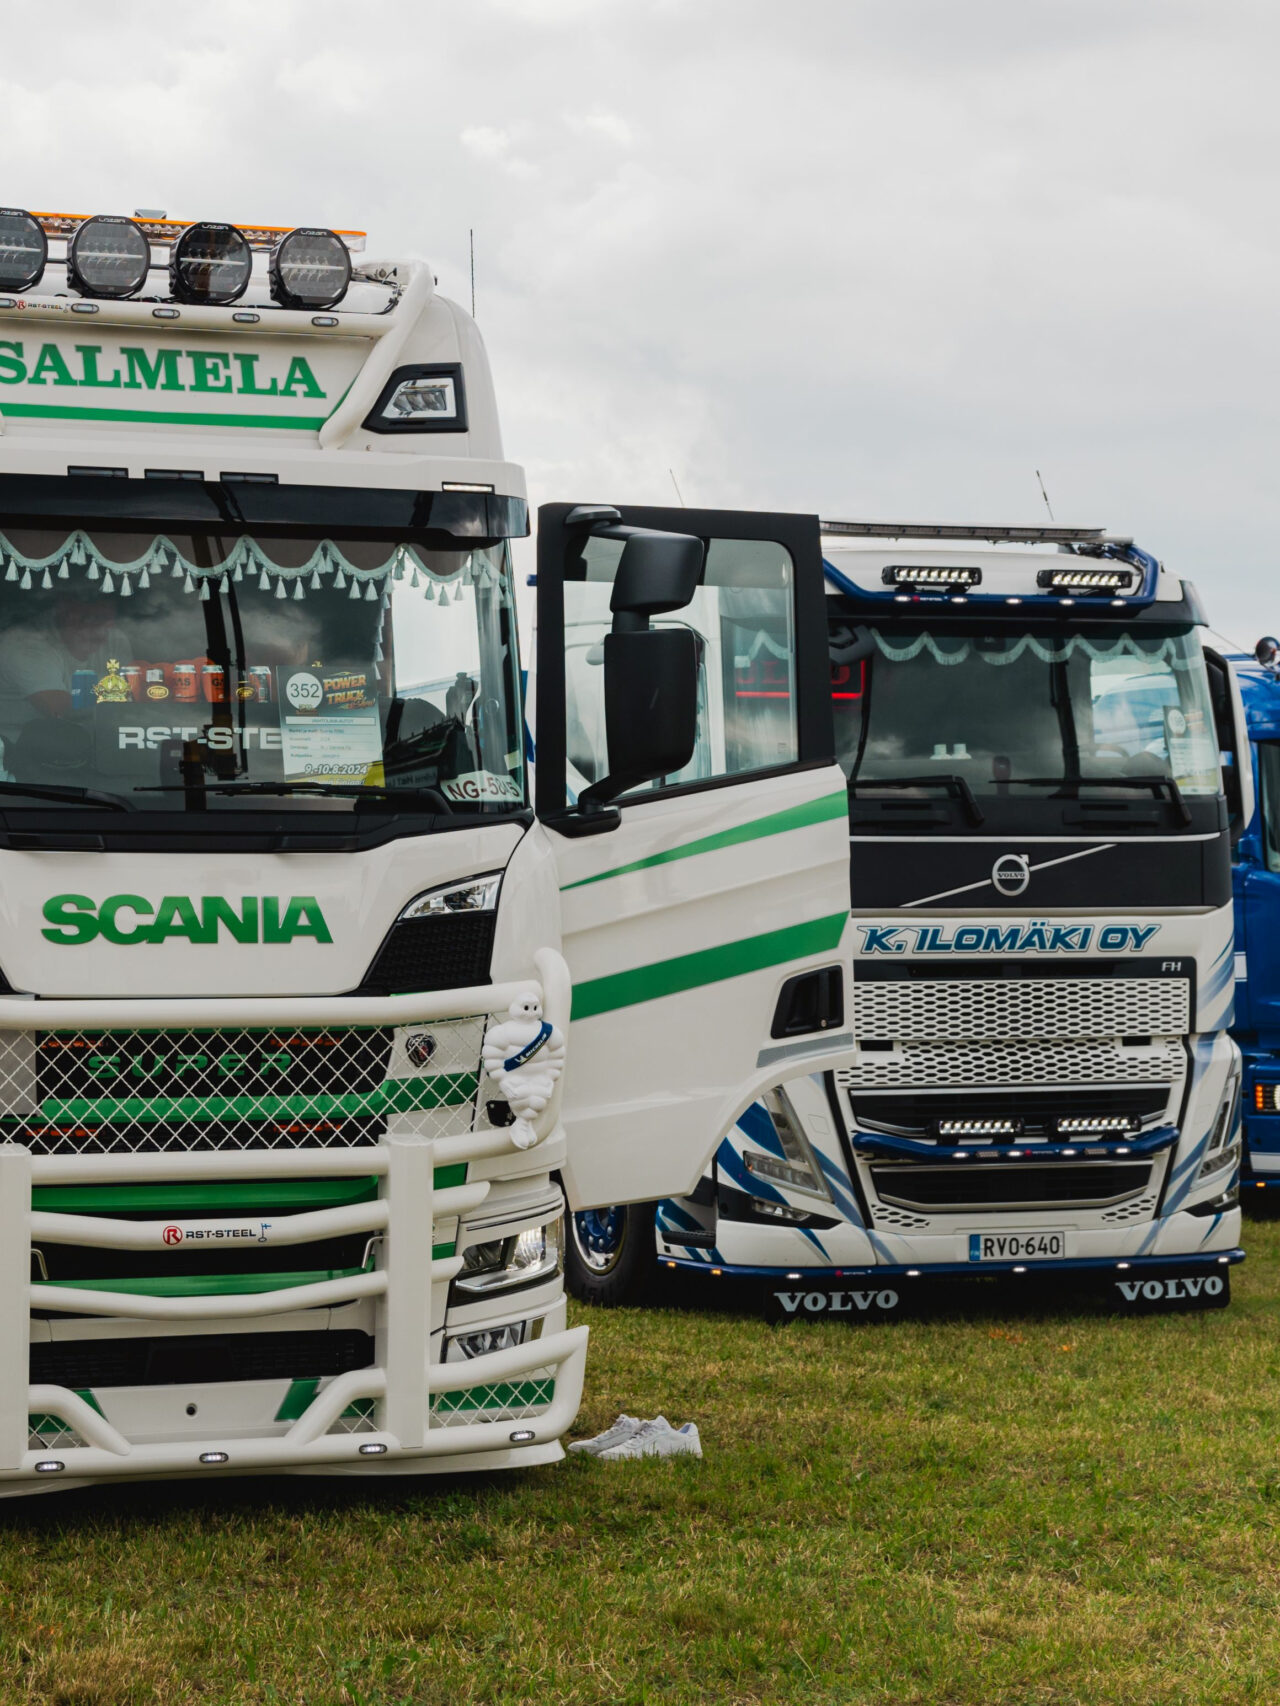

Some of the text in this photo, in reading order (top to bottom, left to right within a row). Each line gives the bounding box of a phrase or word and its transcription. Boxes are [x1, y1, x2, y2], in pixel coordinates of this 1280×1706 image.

[290, 683, 320, 698] 352
[322, 674, 367, 691] POWER
[326, 689, 366, 705] TRUCK
[304, 763, 369, 775] 9.-10.8.2024
[40, 893, 335, 946] SCANIA
[862, 920, 1158, 951] K. ILOMÄKI OY
[1160, 961, 1182, 972] FH
[86, 1053, 293, 1079] SUPER
[185, 1229, 257, 1239] RST-STEEL
[1115, 1275, 1224, 1301] VOLVO
[773, 1289, 899, 1313] VOLVO
